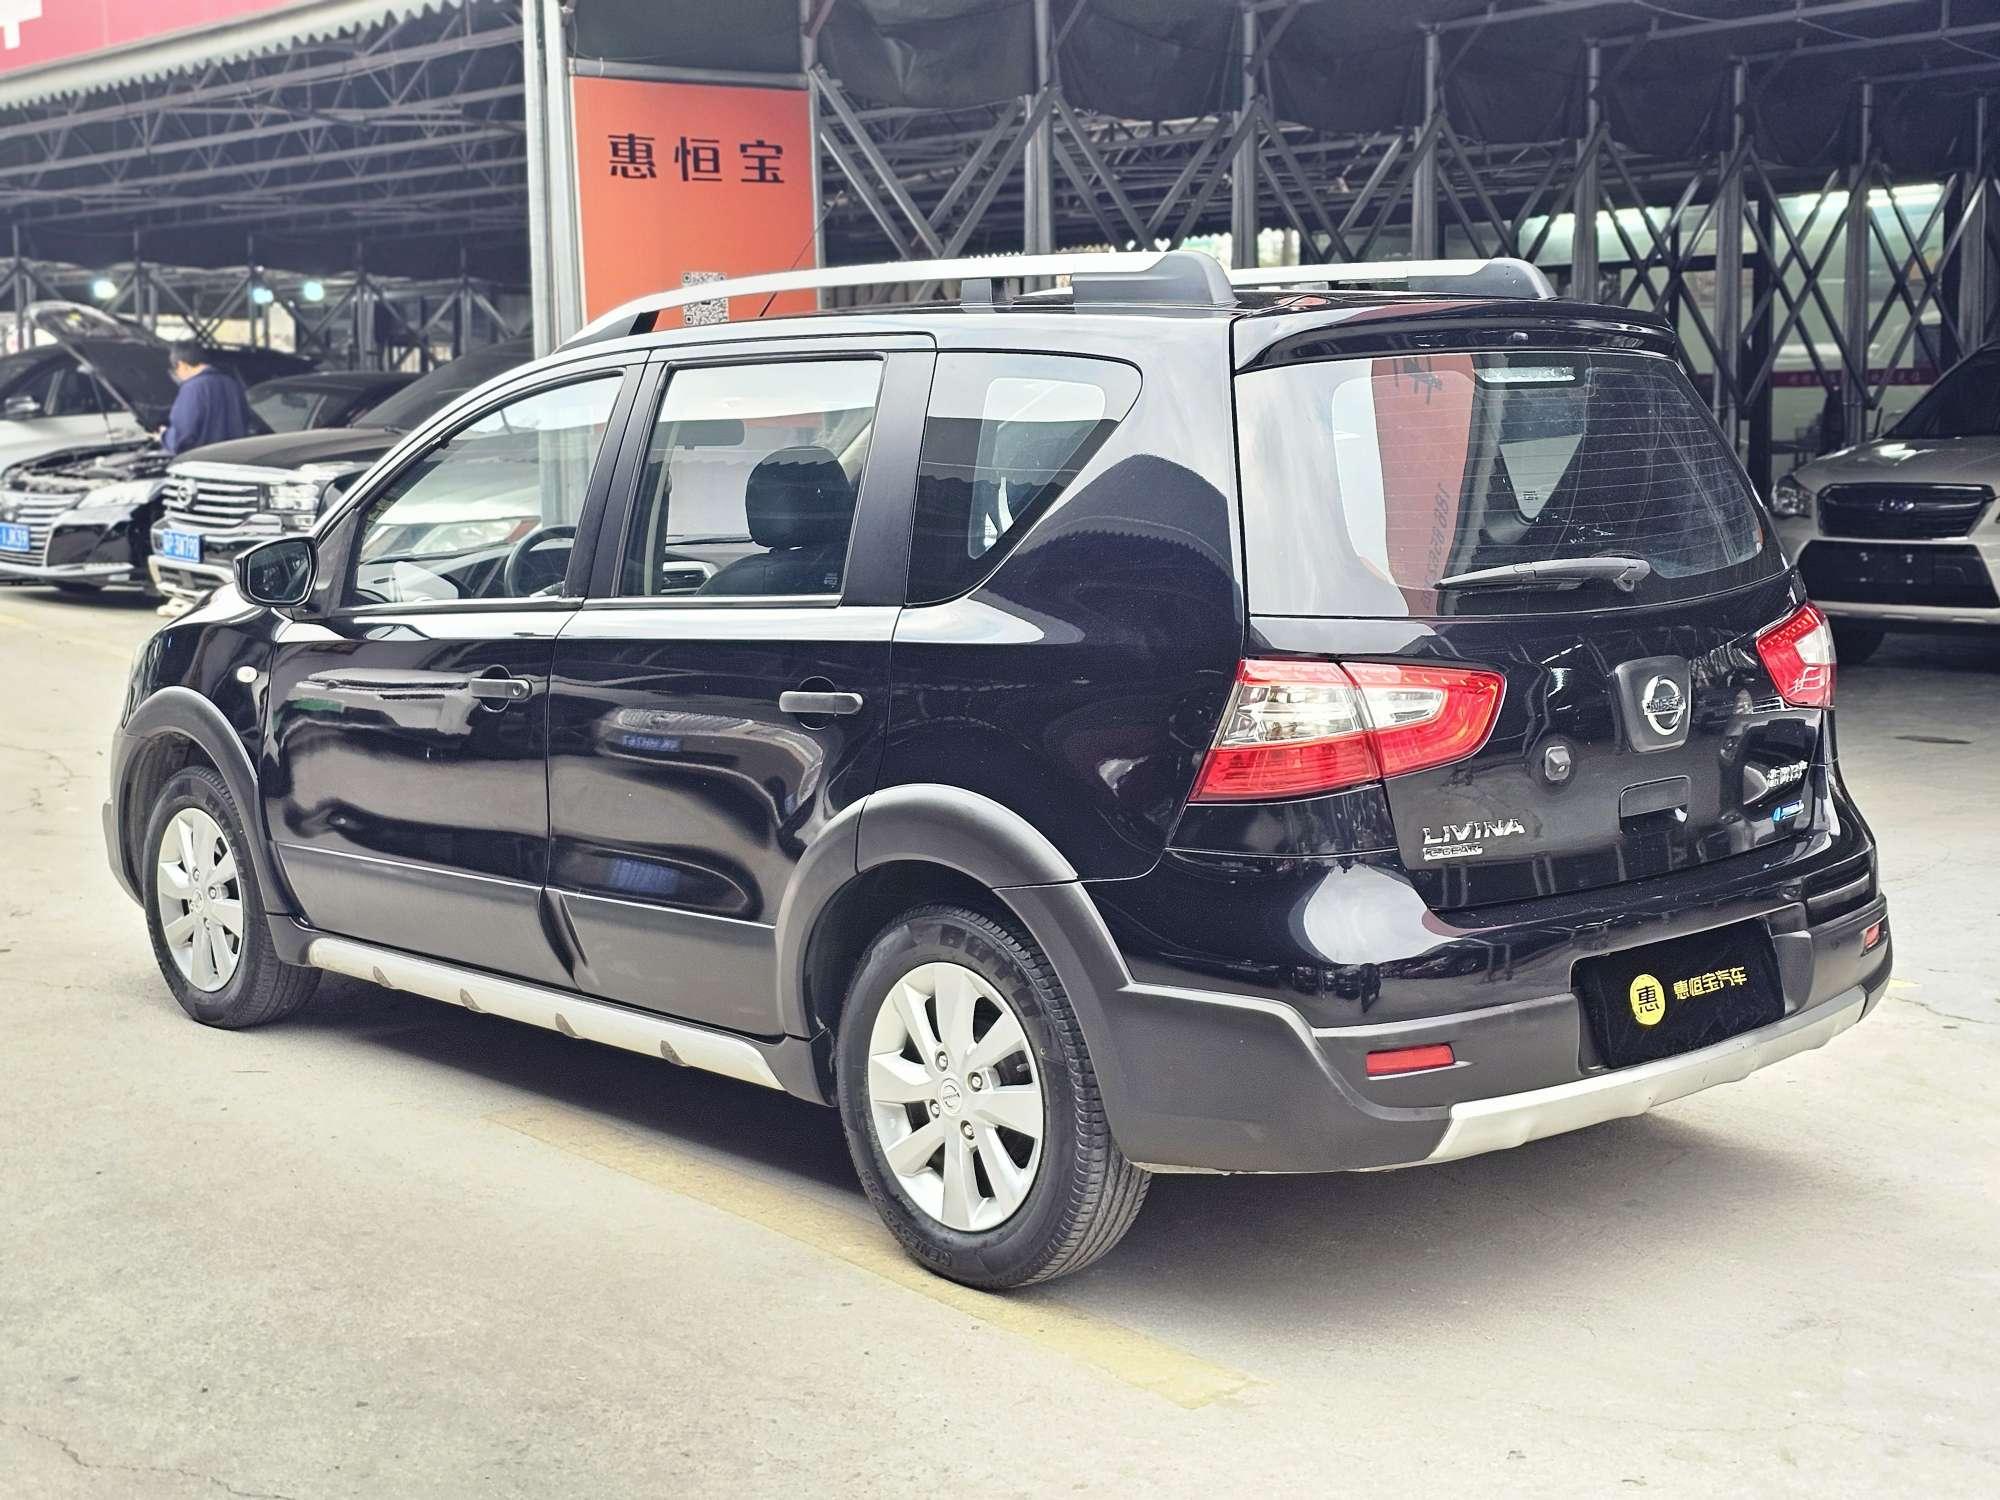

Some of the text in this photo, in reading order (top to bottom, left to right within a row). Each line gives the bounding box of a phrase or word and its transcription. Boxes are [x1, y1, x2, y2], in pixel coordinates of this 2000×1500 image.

[608, 133, 784, 184] 惠恒宝
[1422, 818, 1526, 845] LIVINA
[1636, 966, 1748, 1014] 惠 惠恒宝汽车
